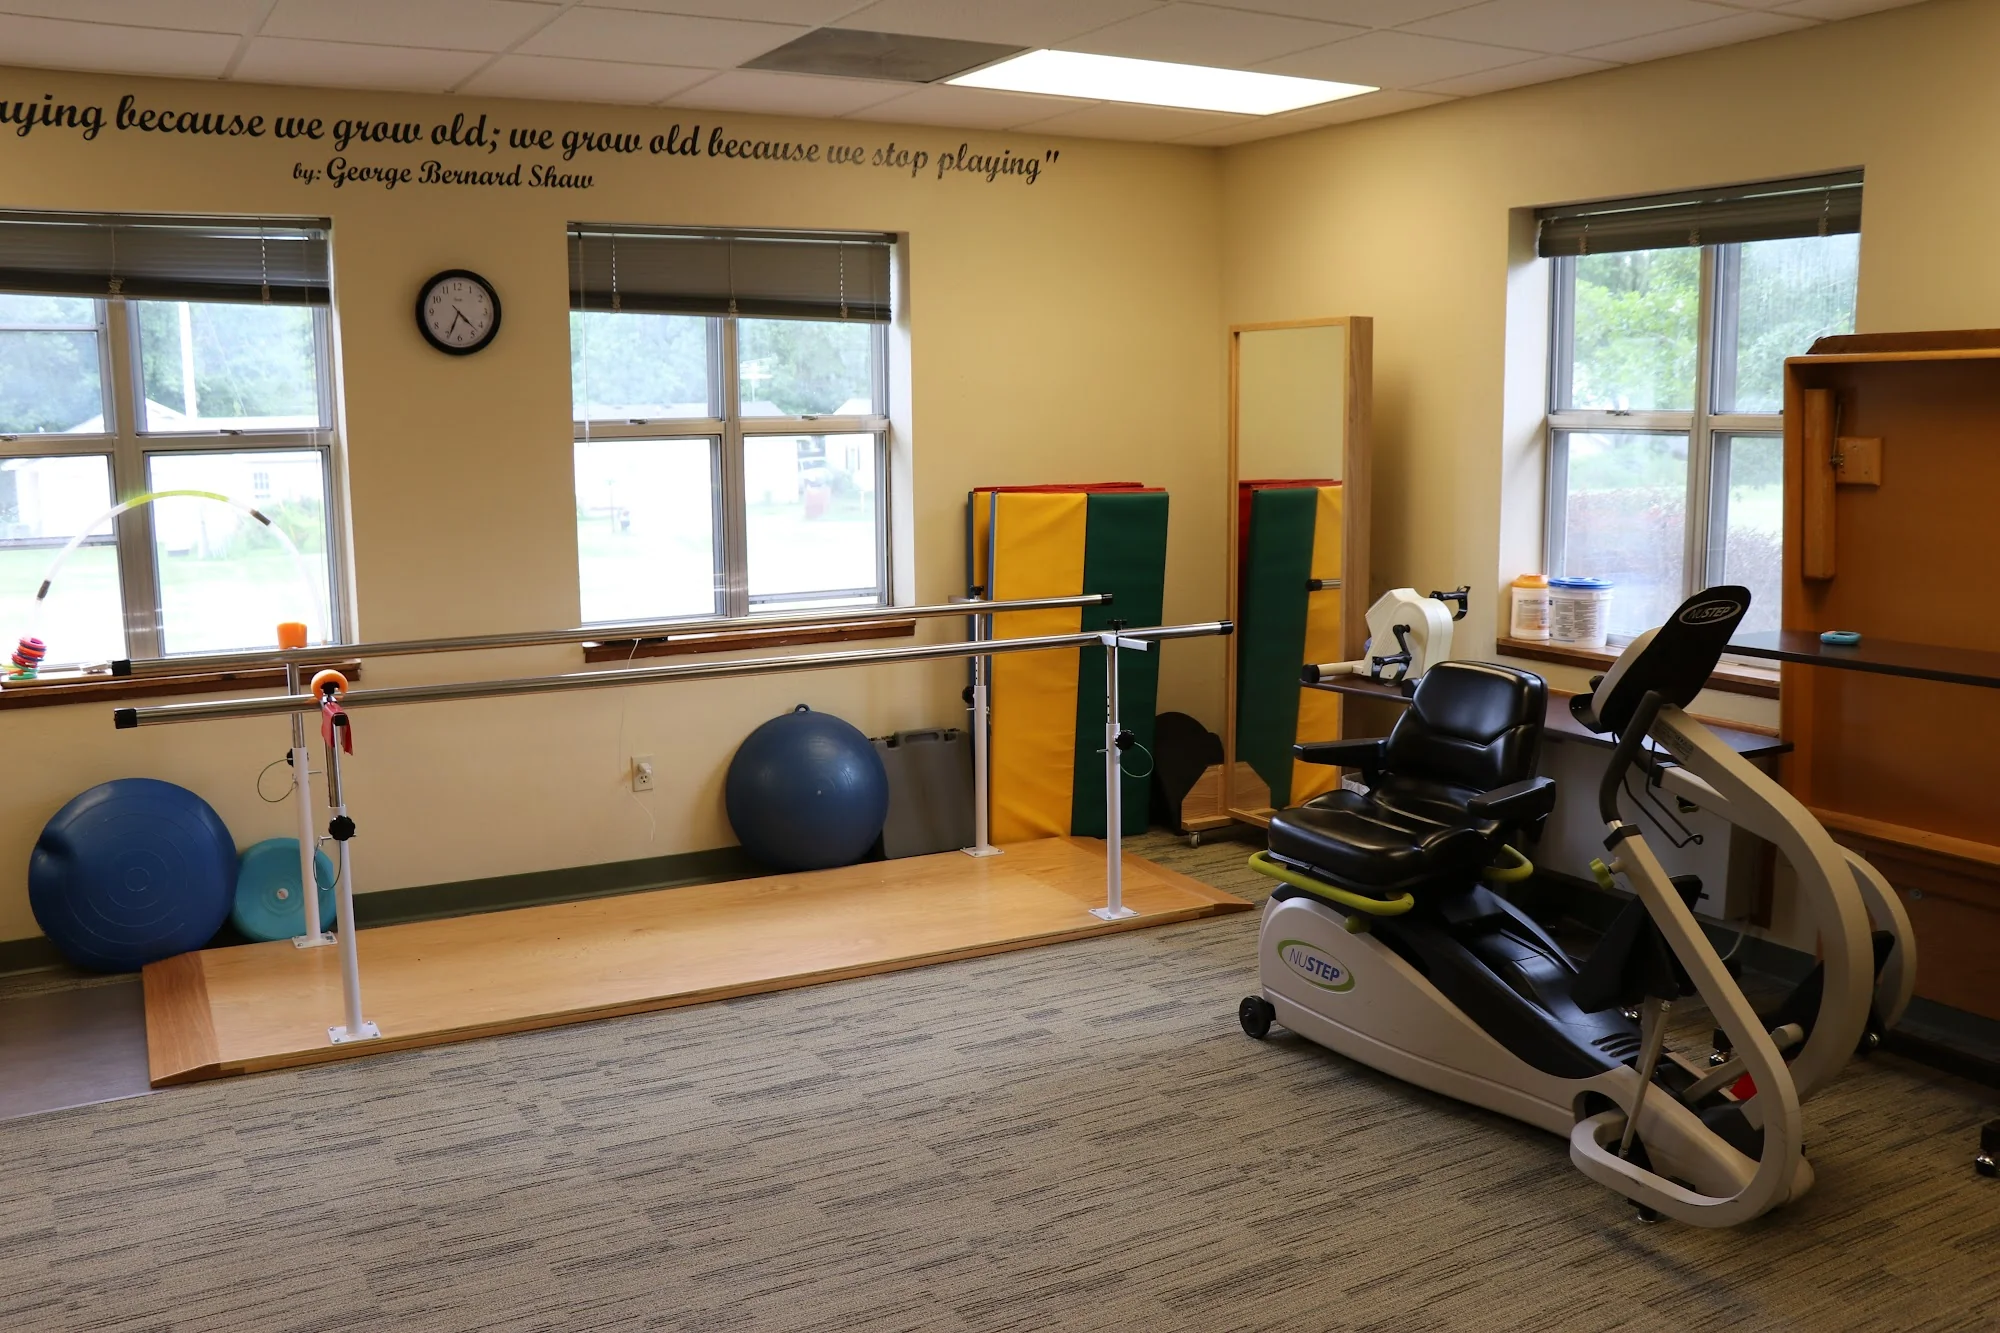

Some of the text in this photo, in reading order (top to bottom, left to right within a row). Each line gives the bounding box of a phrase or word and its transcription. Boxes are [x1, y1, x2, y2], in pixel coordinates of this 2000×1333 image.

[115, 94, 267, 138] because
[274, 116, 325, 140] we
[332, 119, 424, 153] grow
[430, 112, 501, 155] old;
[509, 128, 555, 150] we
[561, 130, 643, 162] grow
[649, 123, 702, 157] old
[707, 126, 821, 163] because
[827, 145, 866, 166] we
[871, 142, 929, 179] stop
[936, 142, 1061, 186] playing"
[292, 156, 595, 191] by: George Bernard Shaw
[1687, 606, 1732, 620] NUSTEP
[1288, 948, 1341, 982] NUSTEP
